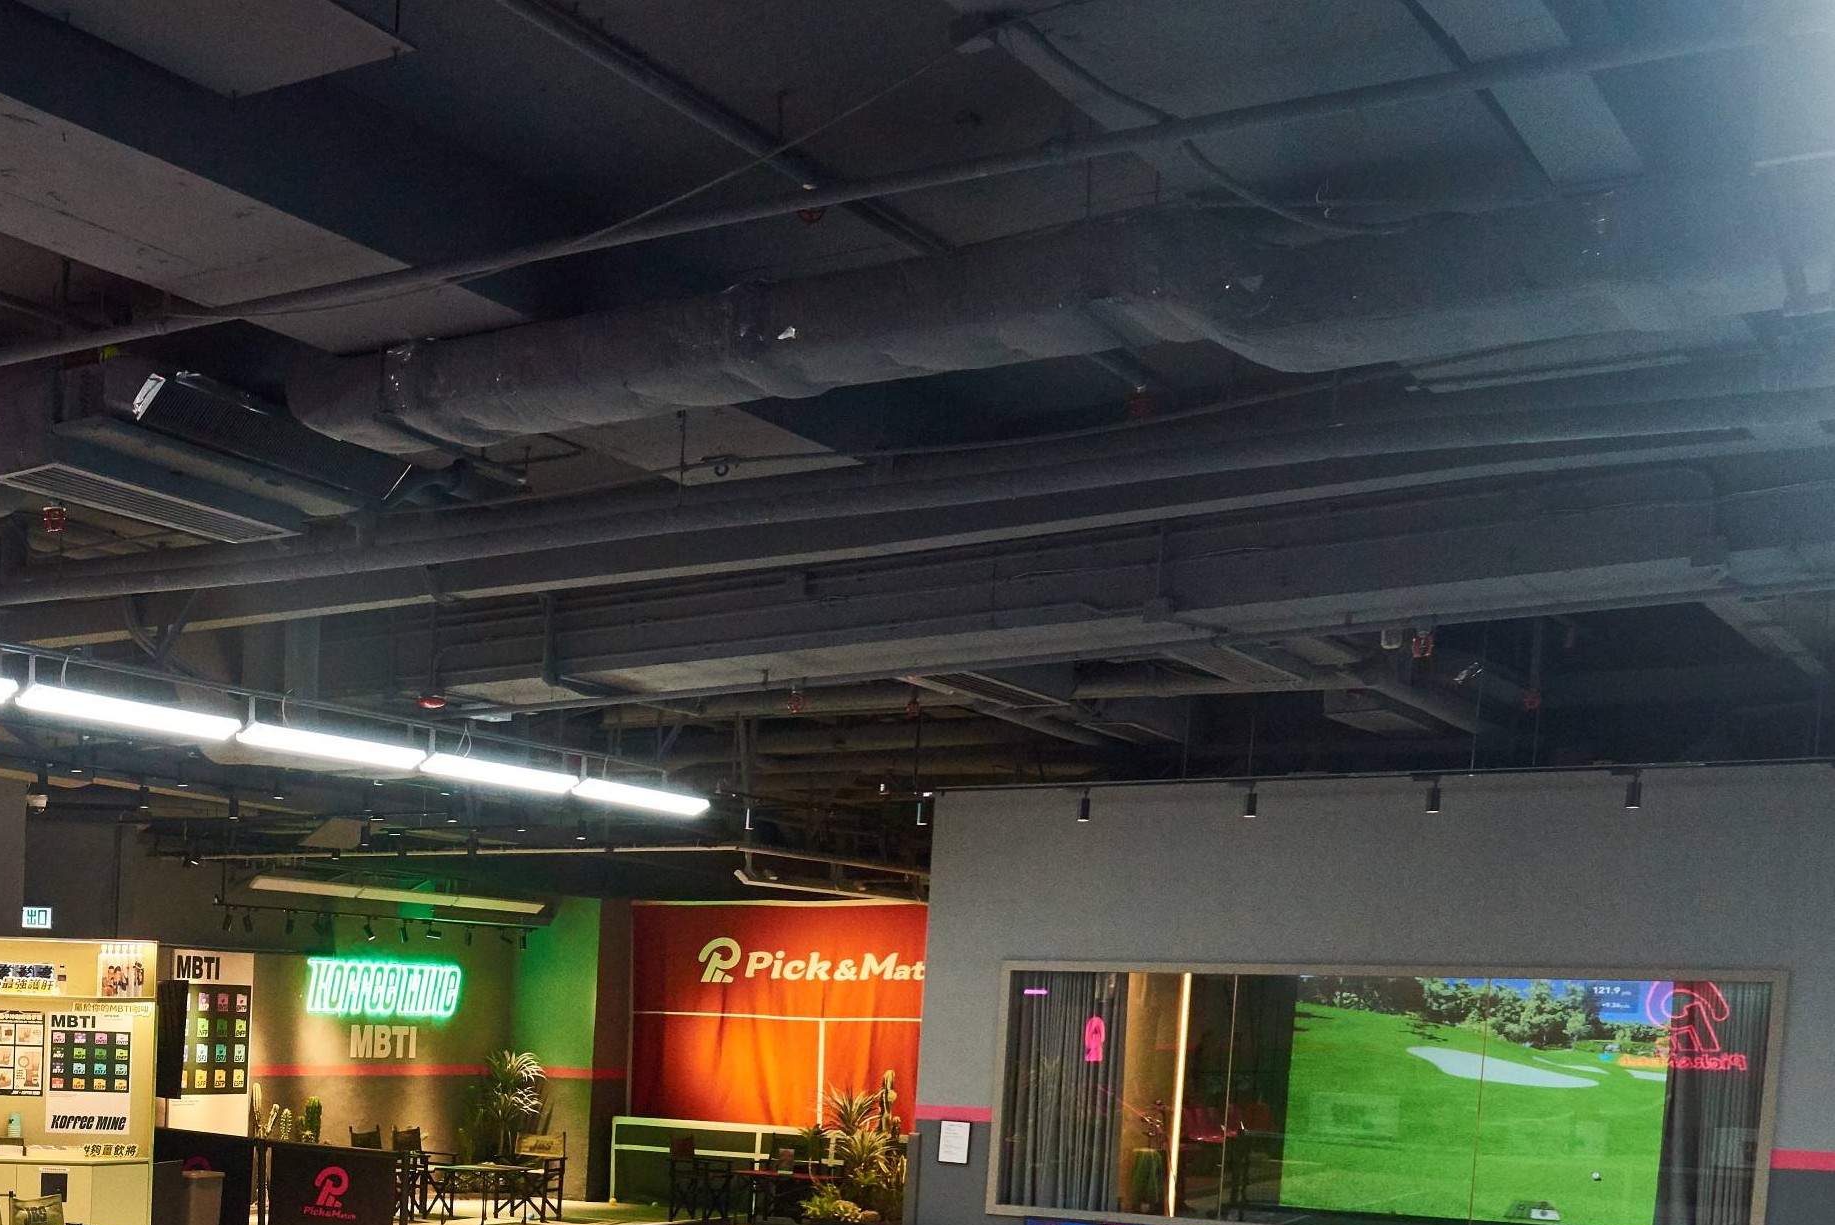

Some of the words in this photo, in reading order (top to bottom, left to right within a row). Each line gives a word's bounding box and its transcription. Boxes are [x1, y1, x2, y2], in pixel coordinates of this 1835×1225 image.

[27, 909, 47, 925] 出口
[176, 954, 221, 980] MBTI
[1592, 986, 1621, 995] 121.9
[51, 1014, 96, 1028] MBTI
[350, 1024, 417, 1059] MBTI
